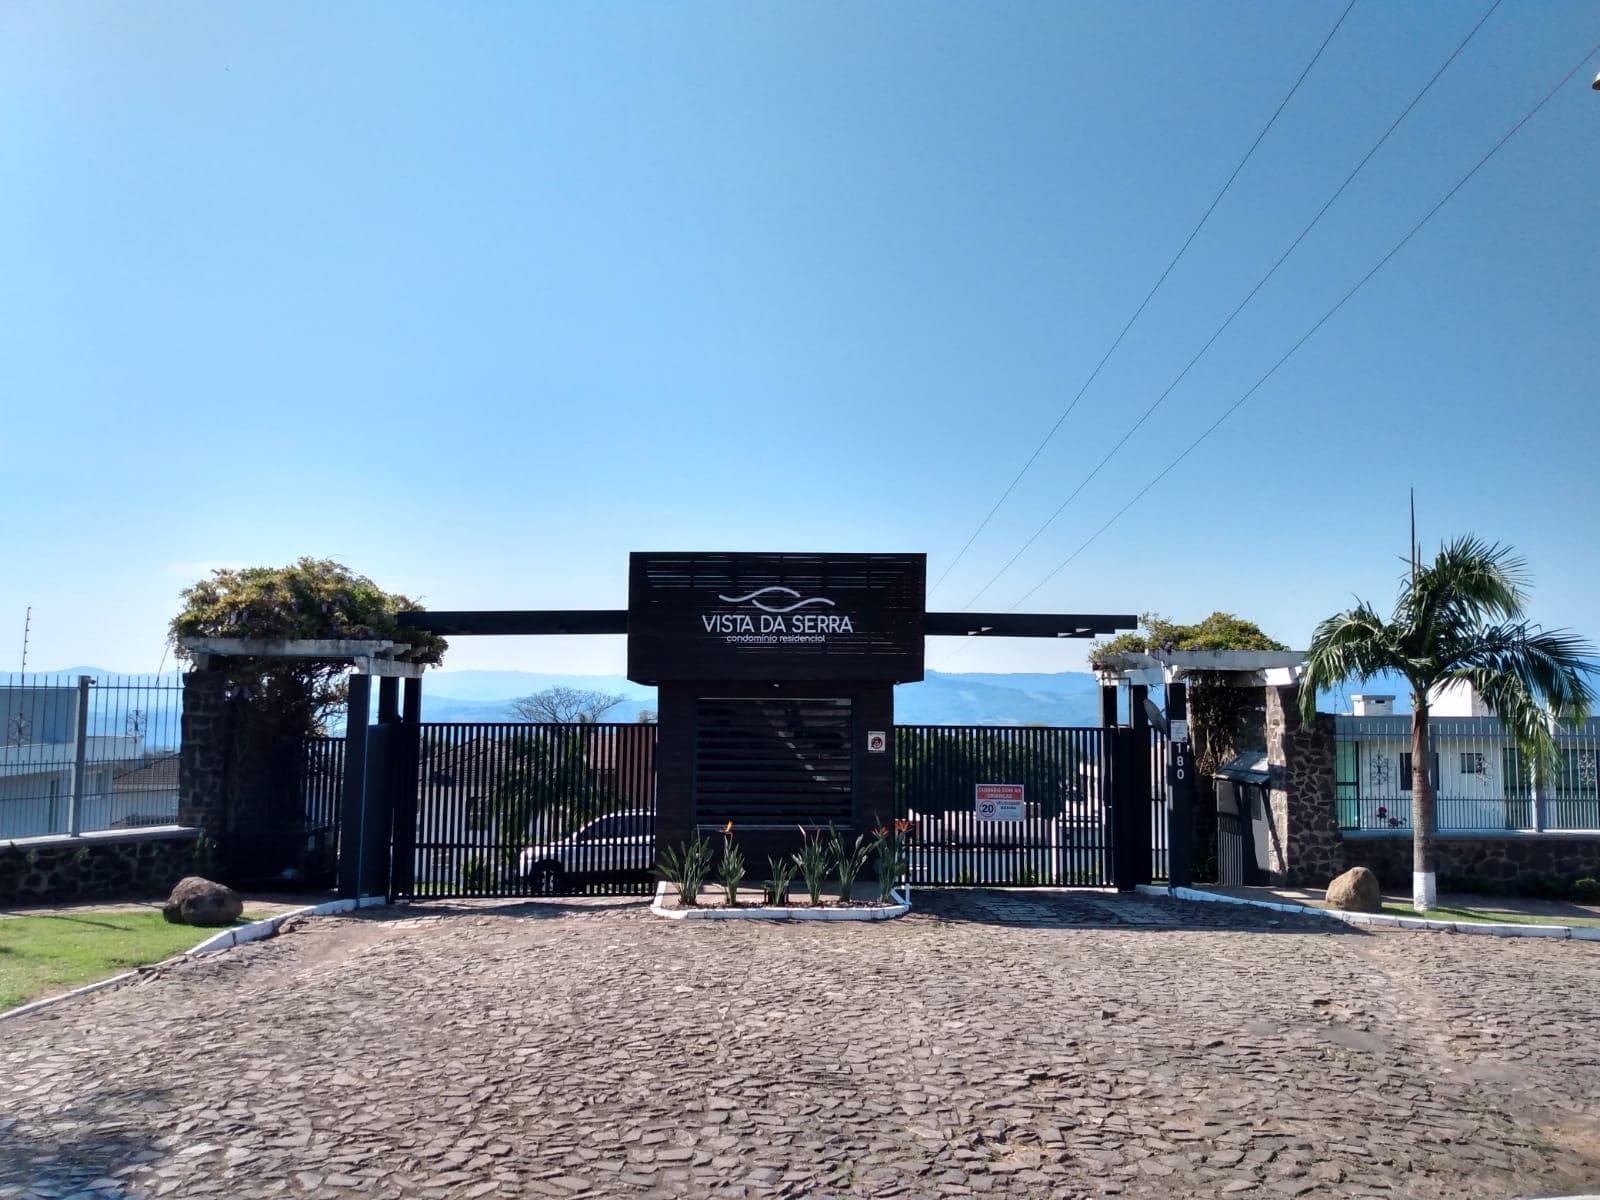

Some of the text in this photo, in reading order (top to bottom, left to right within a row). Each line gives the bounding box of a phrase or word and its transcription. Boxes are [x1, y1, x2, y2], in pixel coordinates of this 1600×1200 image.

[702, 614, 854, 633] VISTA DA SERRA
[726, 634, 826, 643] condomínio residencial
[1176, 743, 1184, 780] 180
[982, 804, 994, 813] 20
